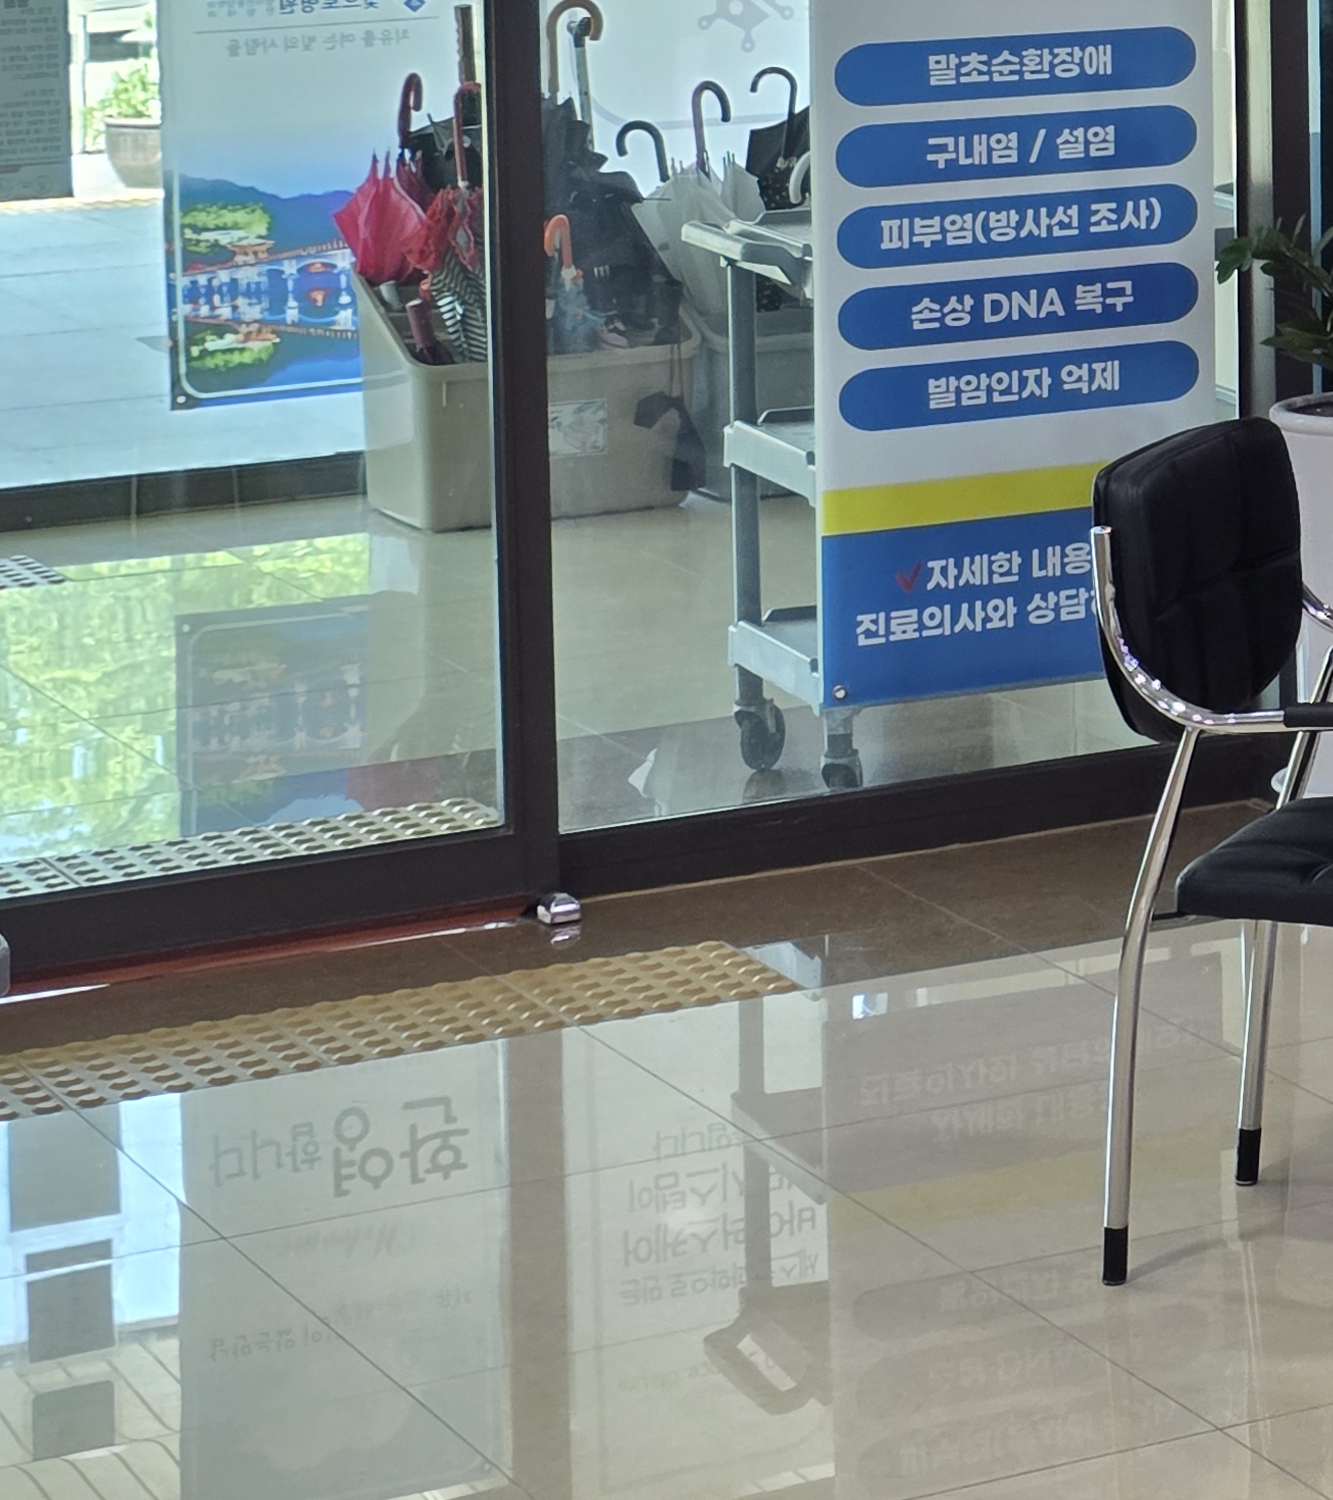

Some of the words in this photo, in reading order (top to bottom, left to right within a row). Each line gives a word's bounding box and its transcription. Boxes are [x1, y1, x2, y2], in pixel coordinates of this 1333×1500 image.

[928, 43, 1113, 86] 말초순환장애
[926, 129, 1019, 169] 구내염
[1056, 123, 1116, 159] 설염
[880, 203, 1079, 252] 피부염(방사선
[1089, 196, 1162, 235] 조사)
[911, 294, 973, 331] 손상
[984, 289, 1065, 323] DNA
[1074, 280, 1134, 314] 복구
[928, 367, 1051, 409] 발암인자
[1061, 359, 1120, 394] 억제
[925, 549, 1022, 592] 자세한
[855, 605, 1016, 648] 진료의사와
[1027, 588, 1099, 626] 상담
